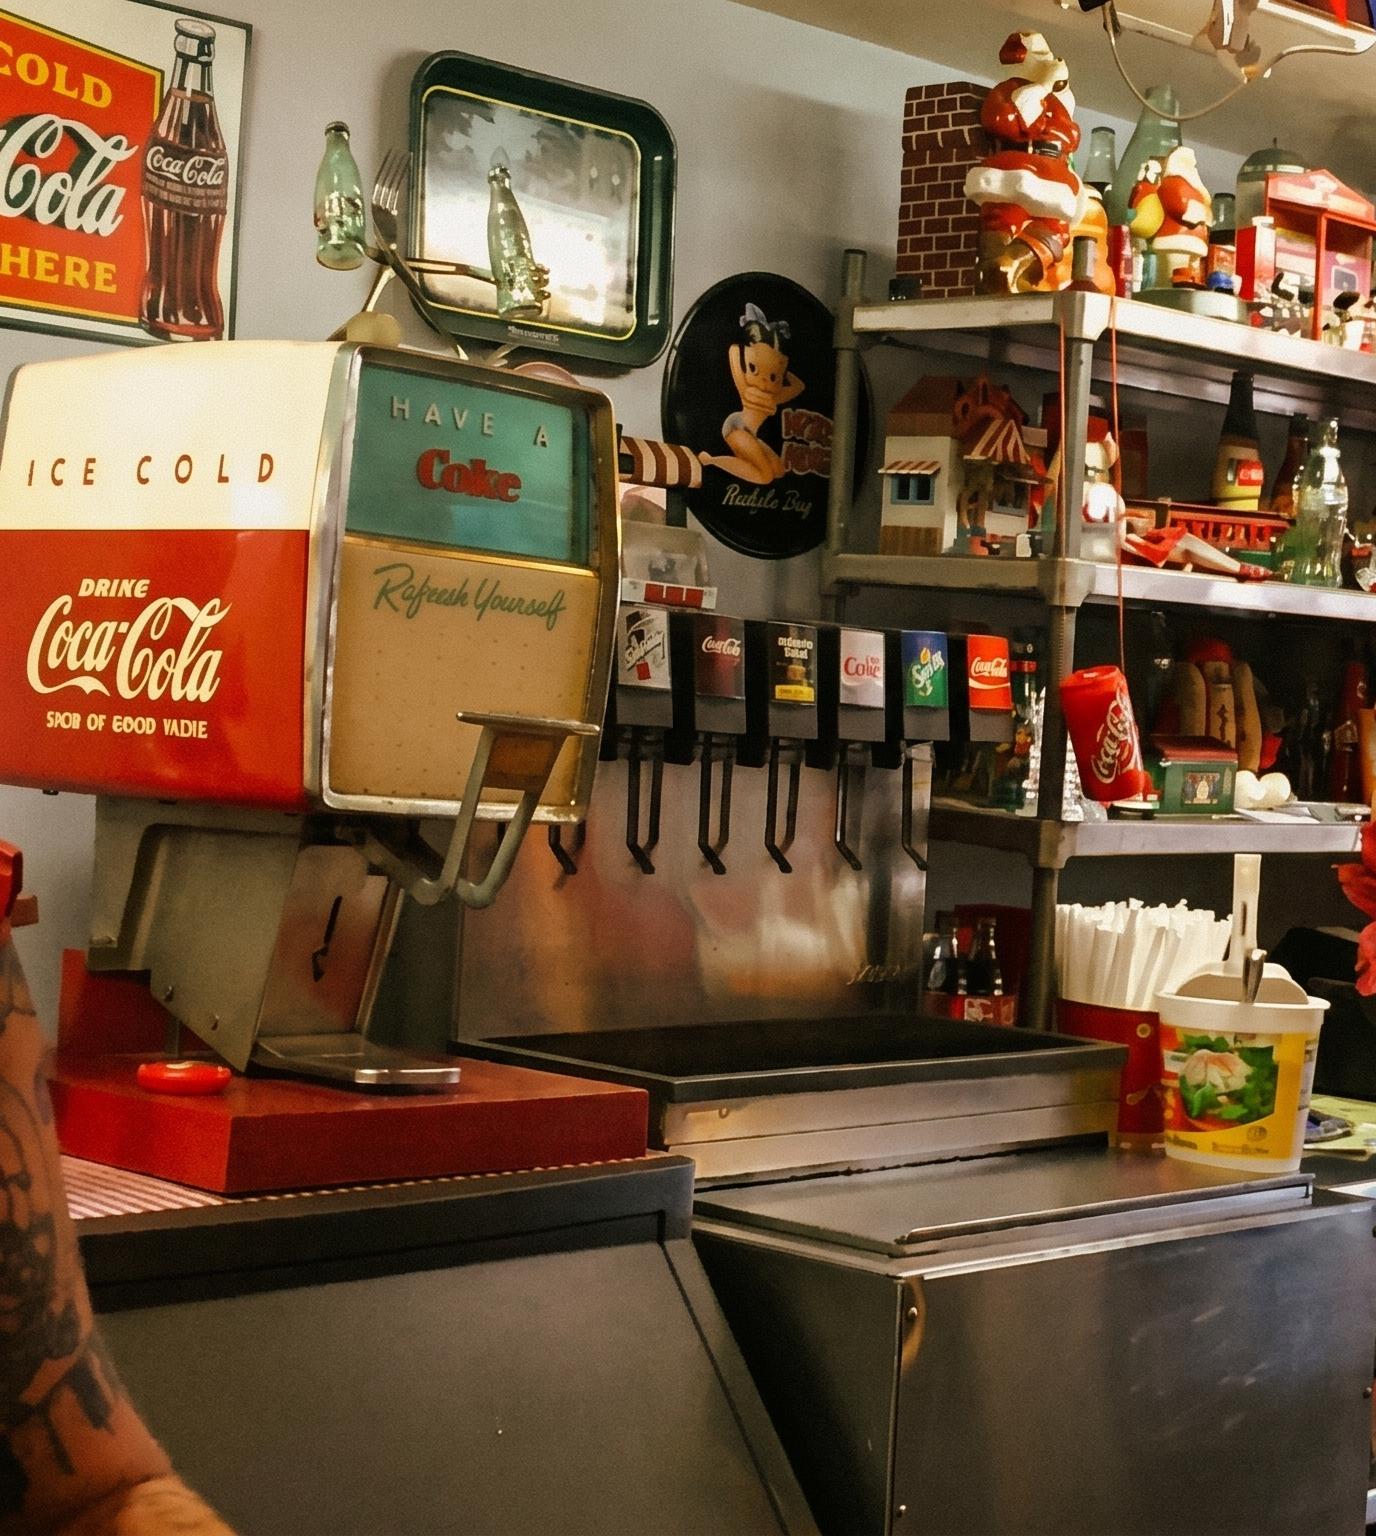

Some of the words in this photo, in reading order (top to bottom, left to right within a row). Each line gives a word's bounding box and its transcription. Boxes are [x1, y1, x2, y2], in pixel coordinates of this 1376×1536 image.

[0, 243, 117, 294] HERE
[391, 395, 495, 437] HAVE
[533, 424, 550, 449] A
[27, 457, 97, 487] ICE
[136, 453, 274, 486] COLD
[416, 448, 523, 503] Coke
[474, 578, 567, 632] Yourself
[26, 594, 233, 703] Coca-Cola
[87, 712, 107, 732] OF
